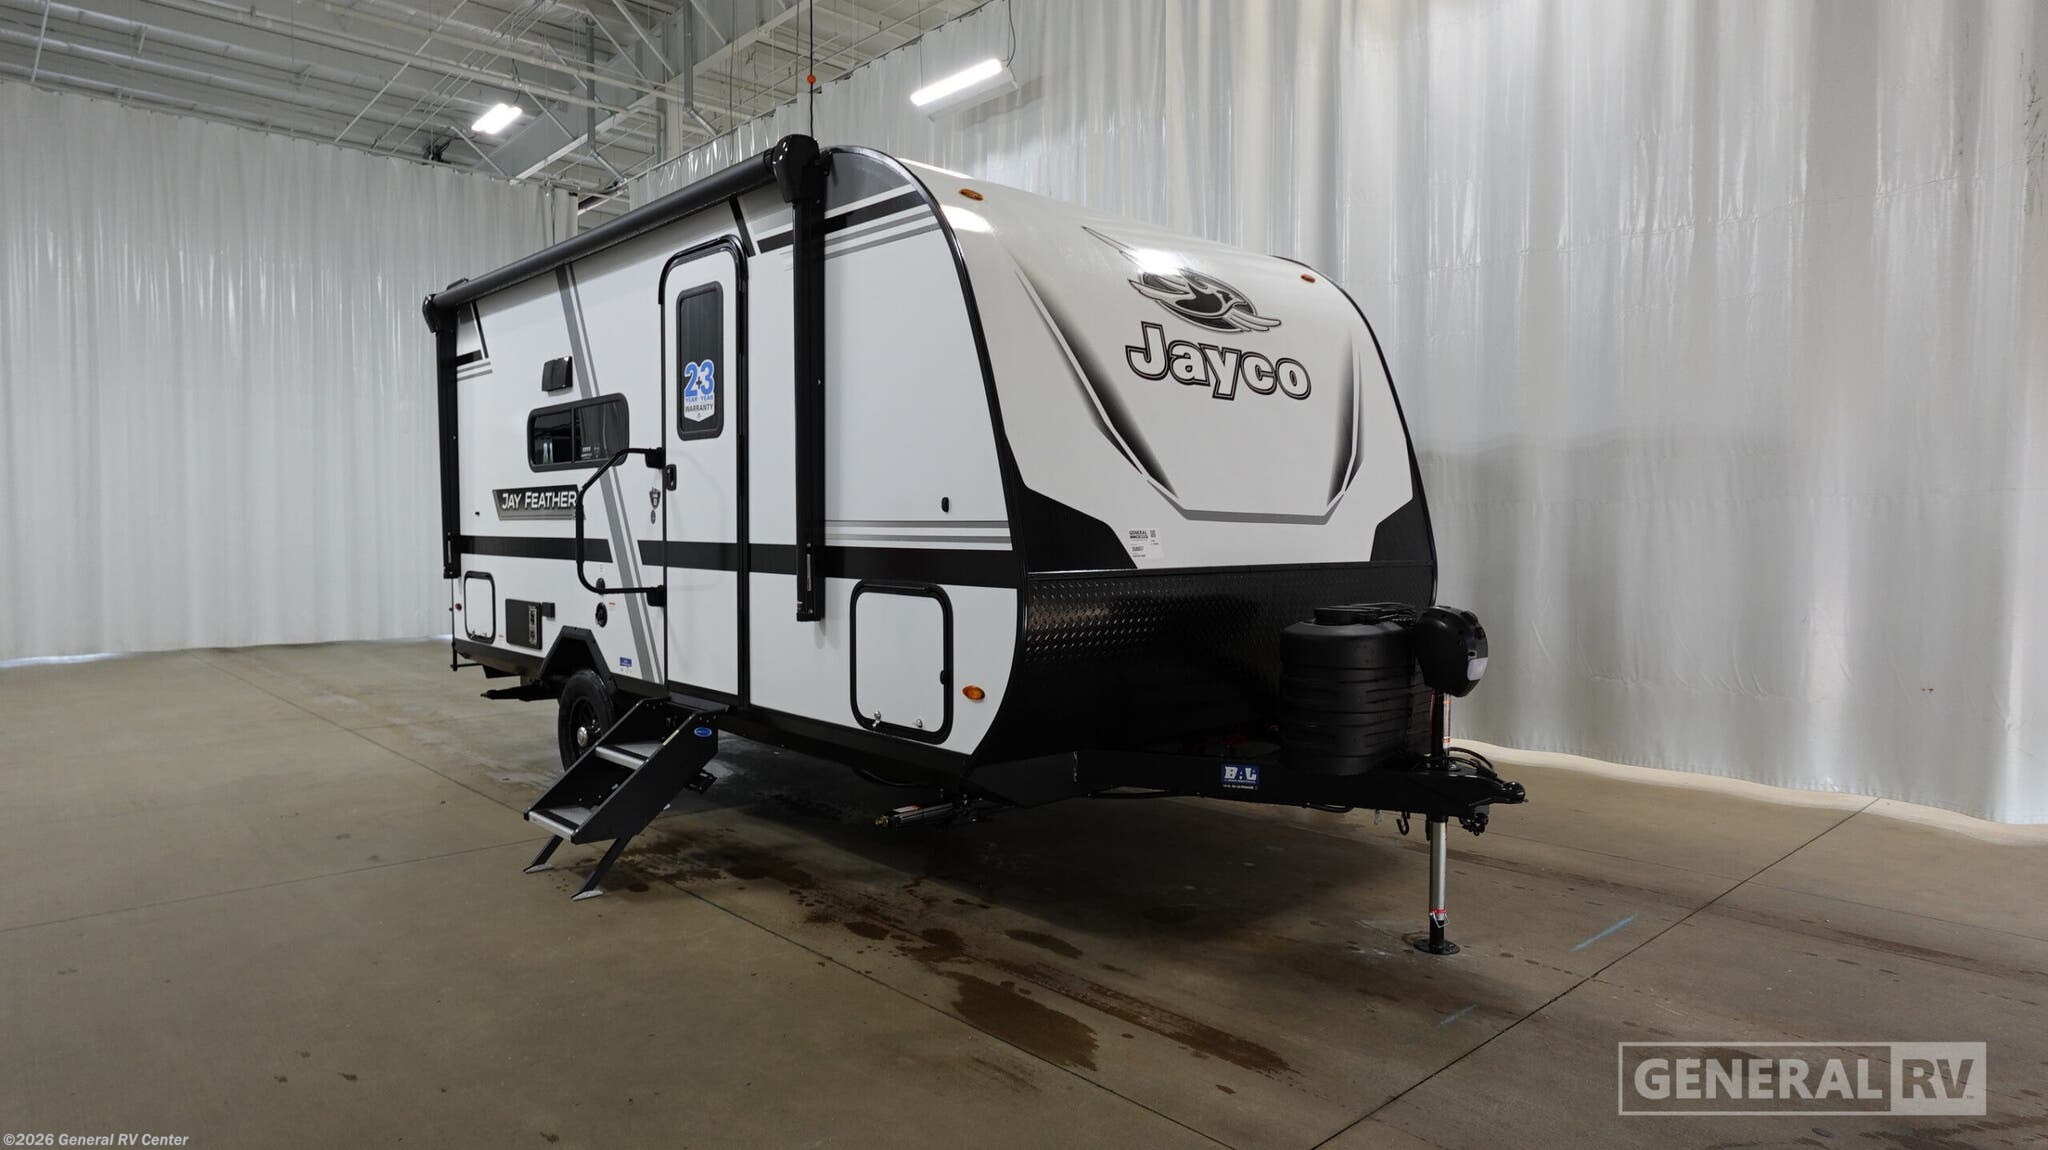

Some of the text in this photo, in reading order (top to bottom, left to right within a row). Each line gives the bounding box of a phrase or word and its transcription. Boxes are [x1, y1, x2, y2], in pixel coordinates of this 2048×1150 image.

[1125, 321, 1312, 400] Jayco
[685, 403, 714, 412] WARRANTY
[501, 491, 577, 510] JAY FEATHER
